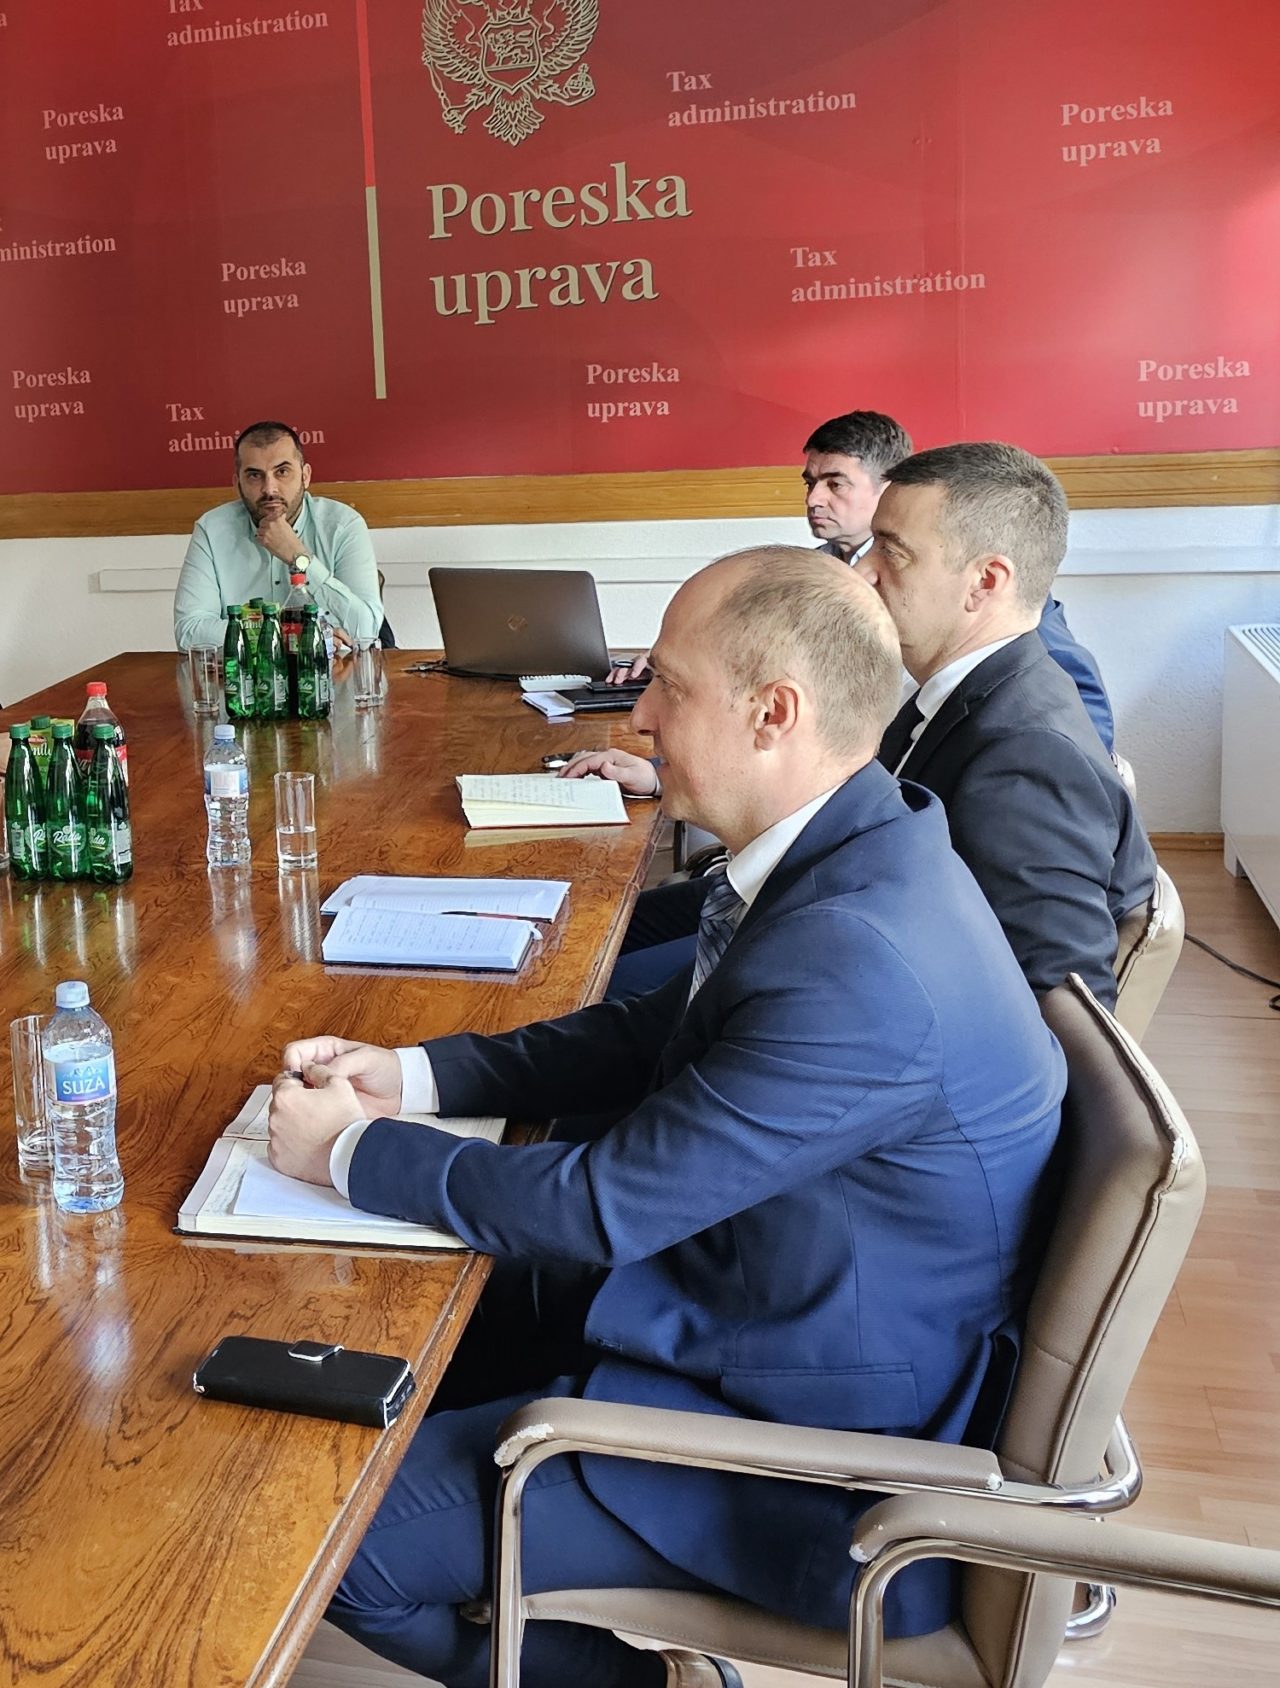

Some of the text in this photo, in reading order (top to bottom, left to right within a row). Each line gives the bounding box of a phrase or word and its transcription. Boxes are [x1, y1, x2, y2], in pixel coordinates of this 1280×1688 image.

[167, 9, 329, 47] administration
[666, 70, 713, 92] Tax
[42, 103, 125, 129] Poreska
[668, 90, 857, 128] administration
[1060, 96, 1174, 126] Poreska
[45, 138, 118, 165] uprava
[1061, 137, 1162, 167] uprava
[426, 161, 693, 240] Poreska
[221, 257, 307, 282] Poreska
[790, 247, 837, 268] Tax
[429, 258, 660, 325] uprava
[791, 270, 986, 303] administration
[223, 293, 299, 318] uprava
[12, 366, 91, 389] Poreska
[586, 362, 680, 385] Poreska
[1138, 356, 1251, 382] Poreska
[14, 400, 85, 423] uprava
[165, 403, 205, 422] Tax
[587, 400, 670, 423] uprava
[1138, 397, 1239, 423] uprava
[62, 1075, 106, 1095] SUZA
